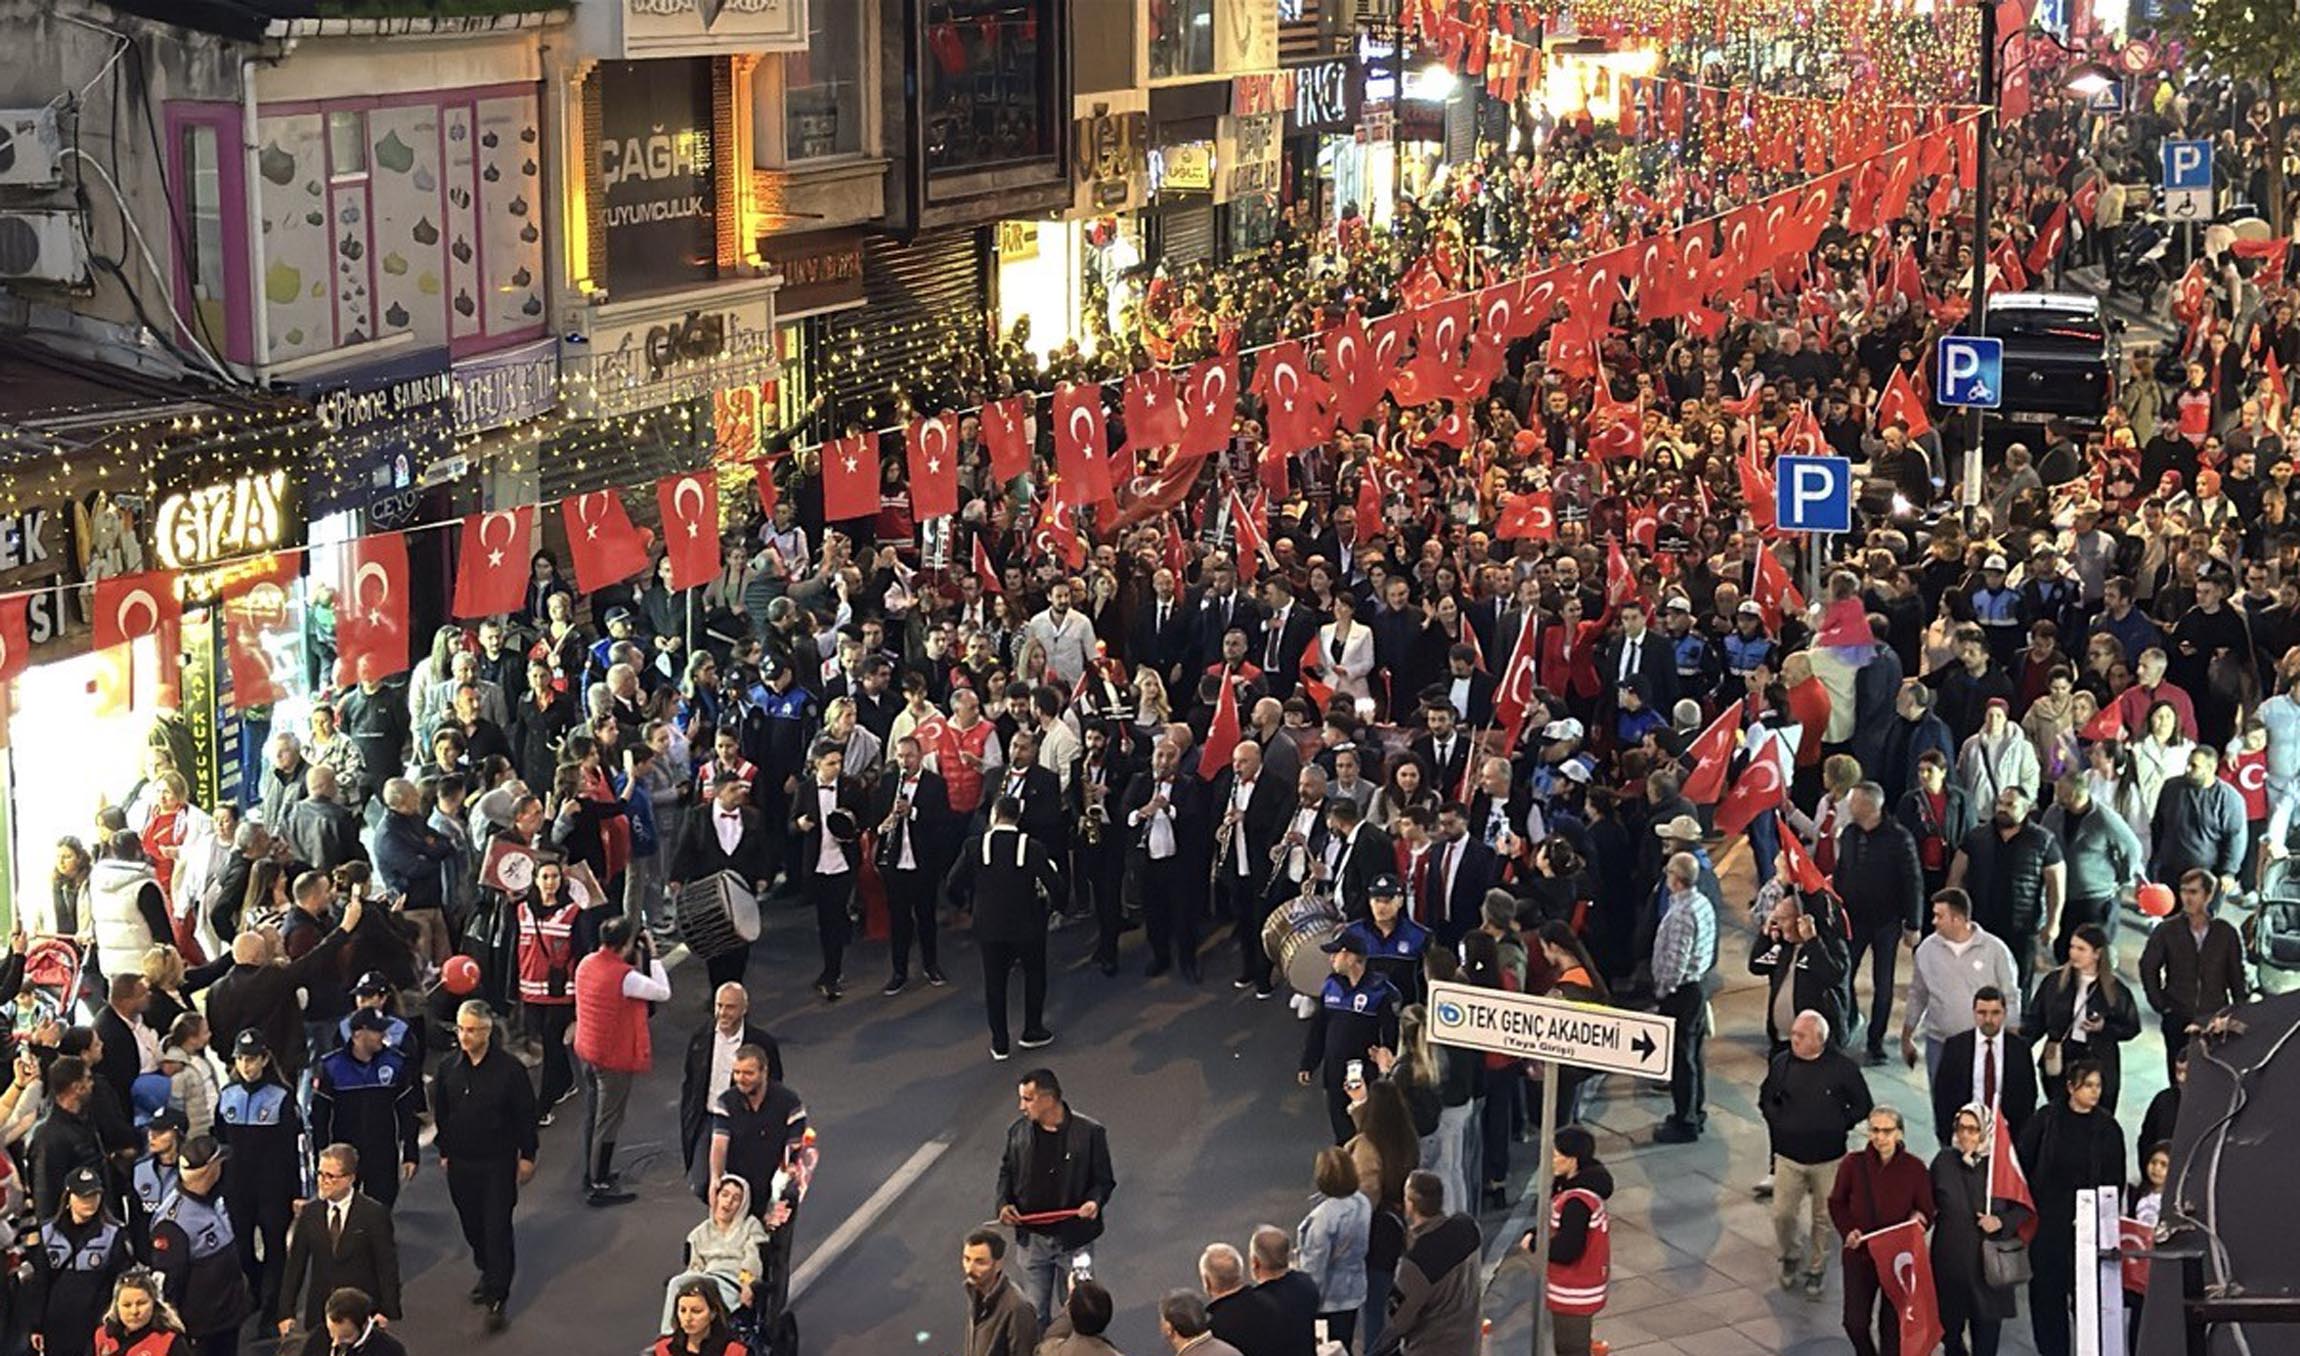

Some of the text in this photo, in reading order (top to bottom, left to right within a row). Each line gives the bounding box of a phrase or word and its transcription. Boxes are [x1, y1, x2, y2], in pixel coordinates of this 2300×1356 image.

[2174, 147, 2200, 184] P
[1946, 344, 1979, 396] P
[1793, 464, 1834, 523] P
[1467, 1004, 1621, 1050] TEK GENÇ AKADEMİ
